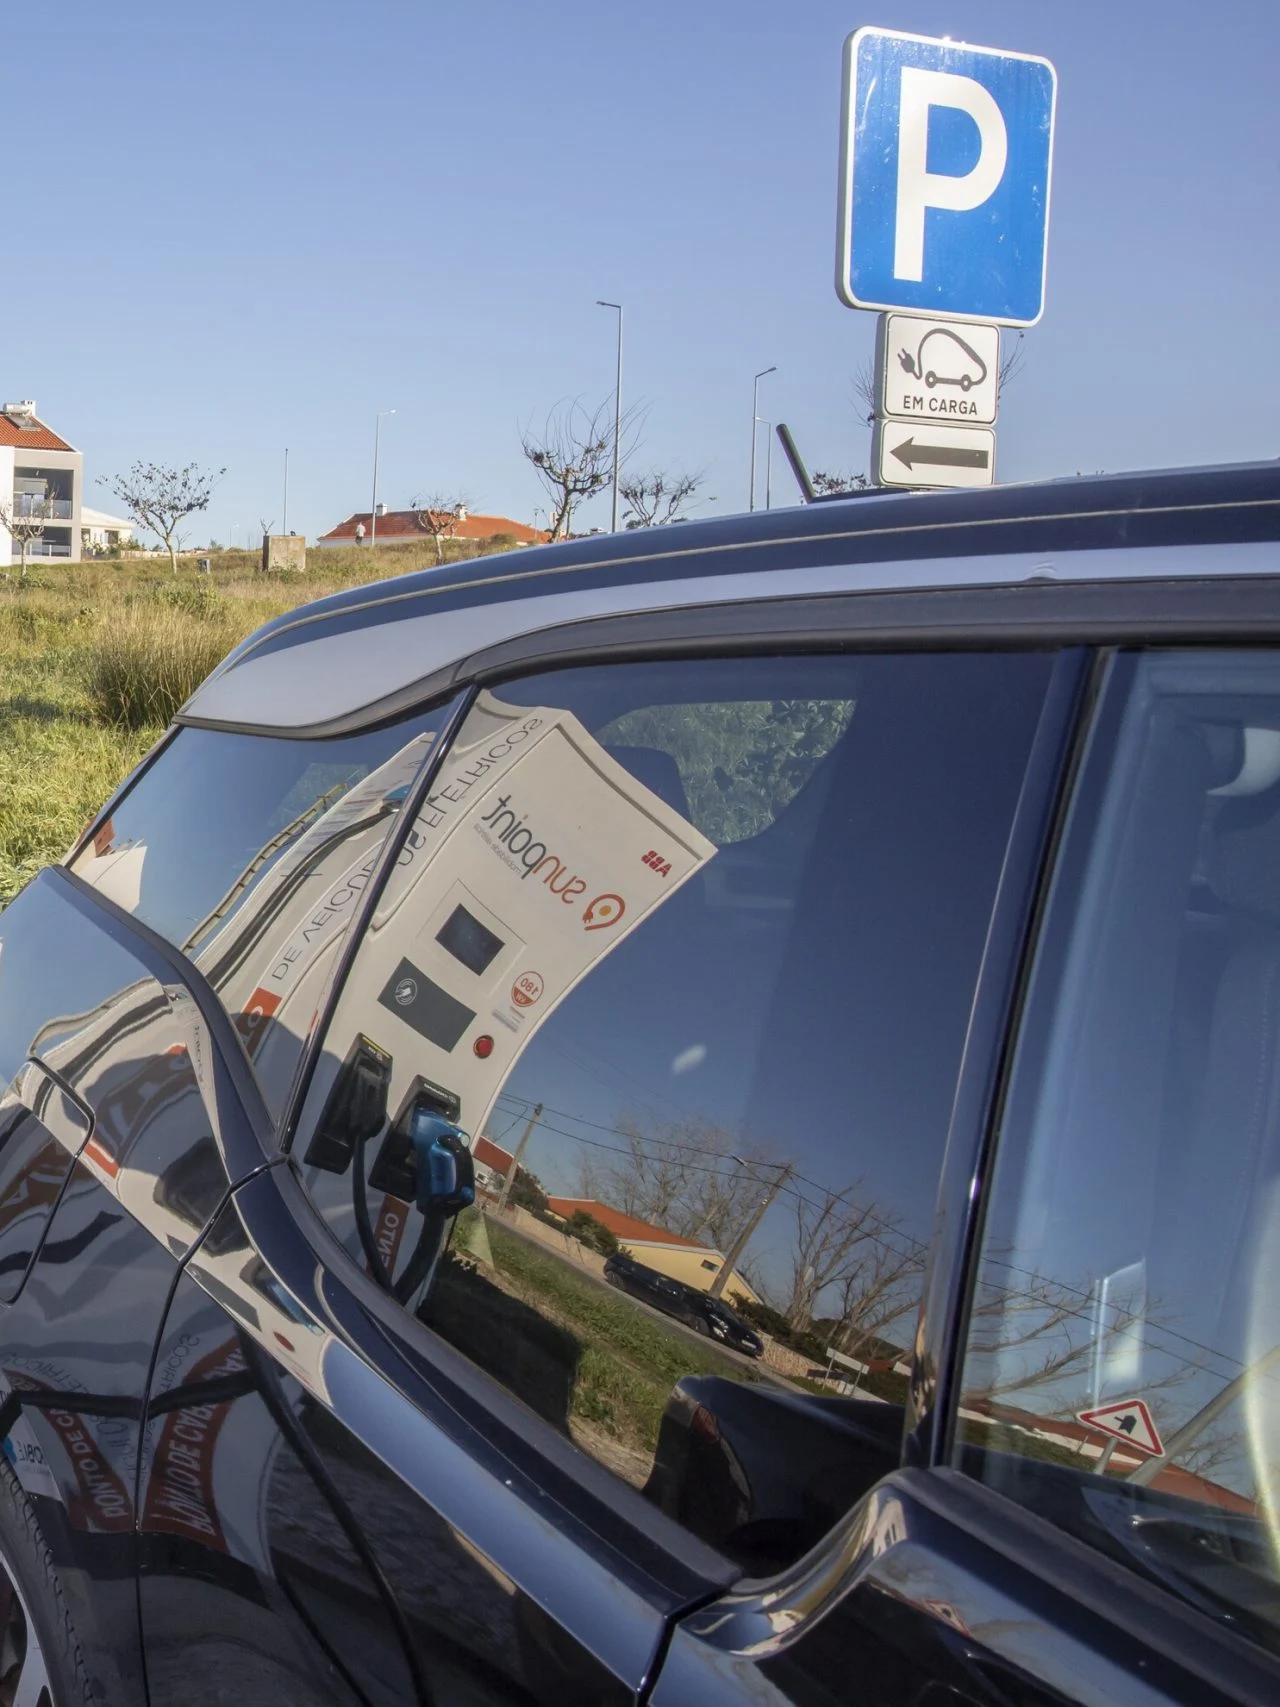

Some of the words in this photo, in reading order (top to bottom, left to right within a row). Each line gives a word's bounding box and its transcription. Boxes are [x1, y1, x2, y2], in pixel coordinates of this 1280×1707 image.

[893, 65, 1008, 283] P
[902, 394, 924, 411] EM
[928, 397, 978, 416] CARGA
